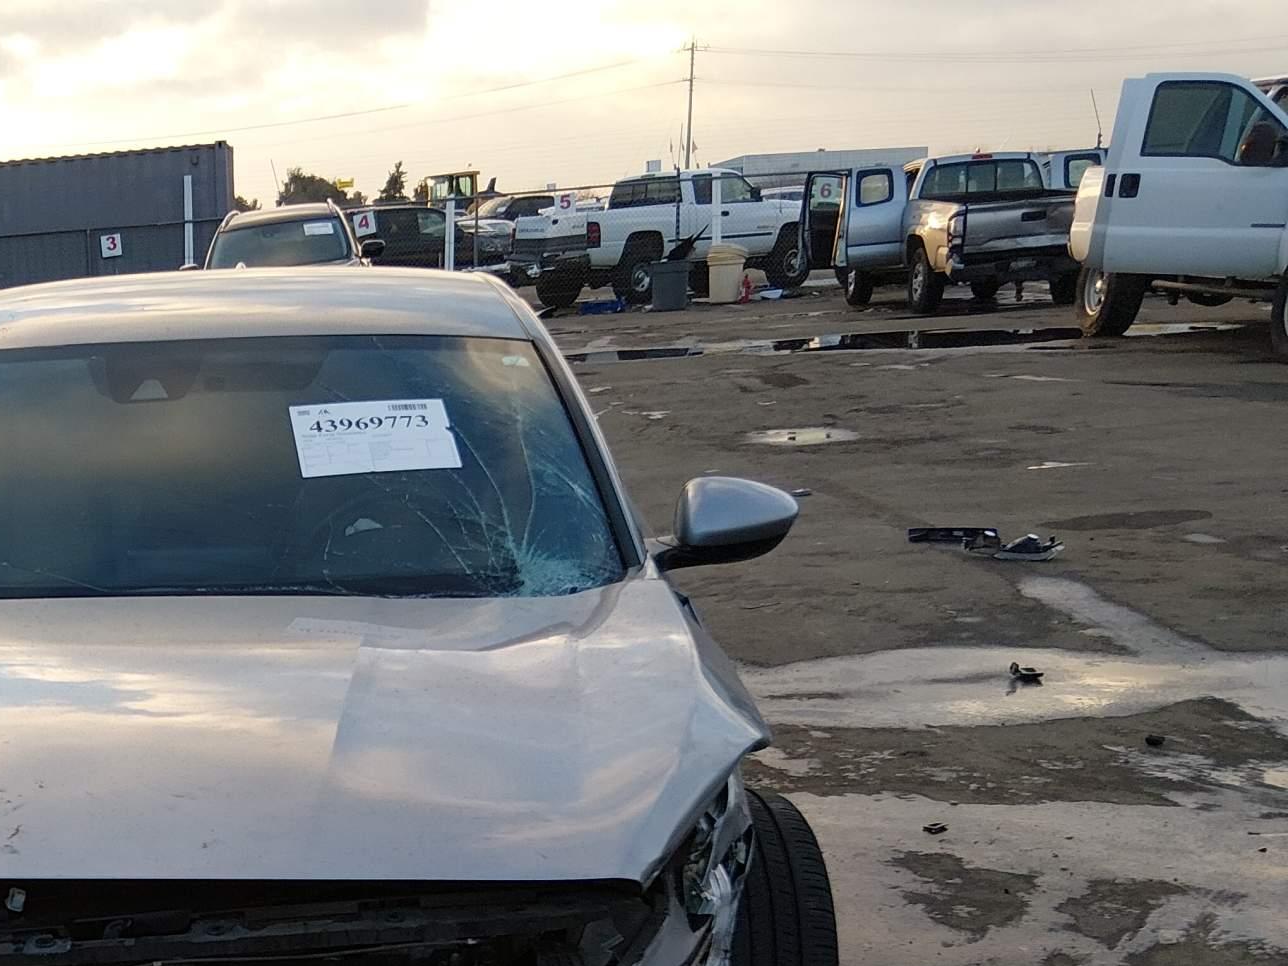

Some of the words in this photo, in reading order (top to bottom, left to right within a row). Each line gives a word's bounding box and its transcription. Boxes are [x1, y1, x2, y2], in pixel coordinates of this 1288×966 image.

[819, 183, 832, 198] 6
[560, 194, 571, 209] 5
[358, 215, 369, 229] 4
[106, 236, 117, 251] 3
[309, 414, 430, 433] 43969773
